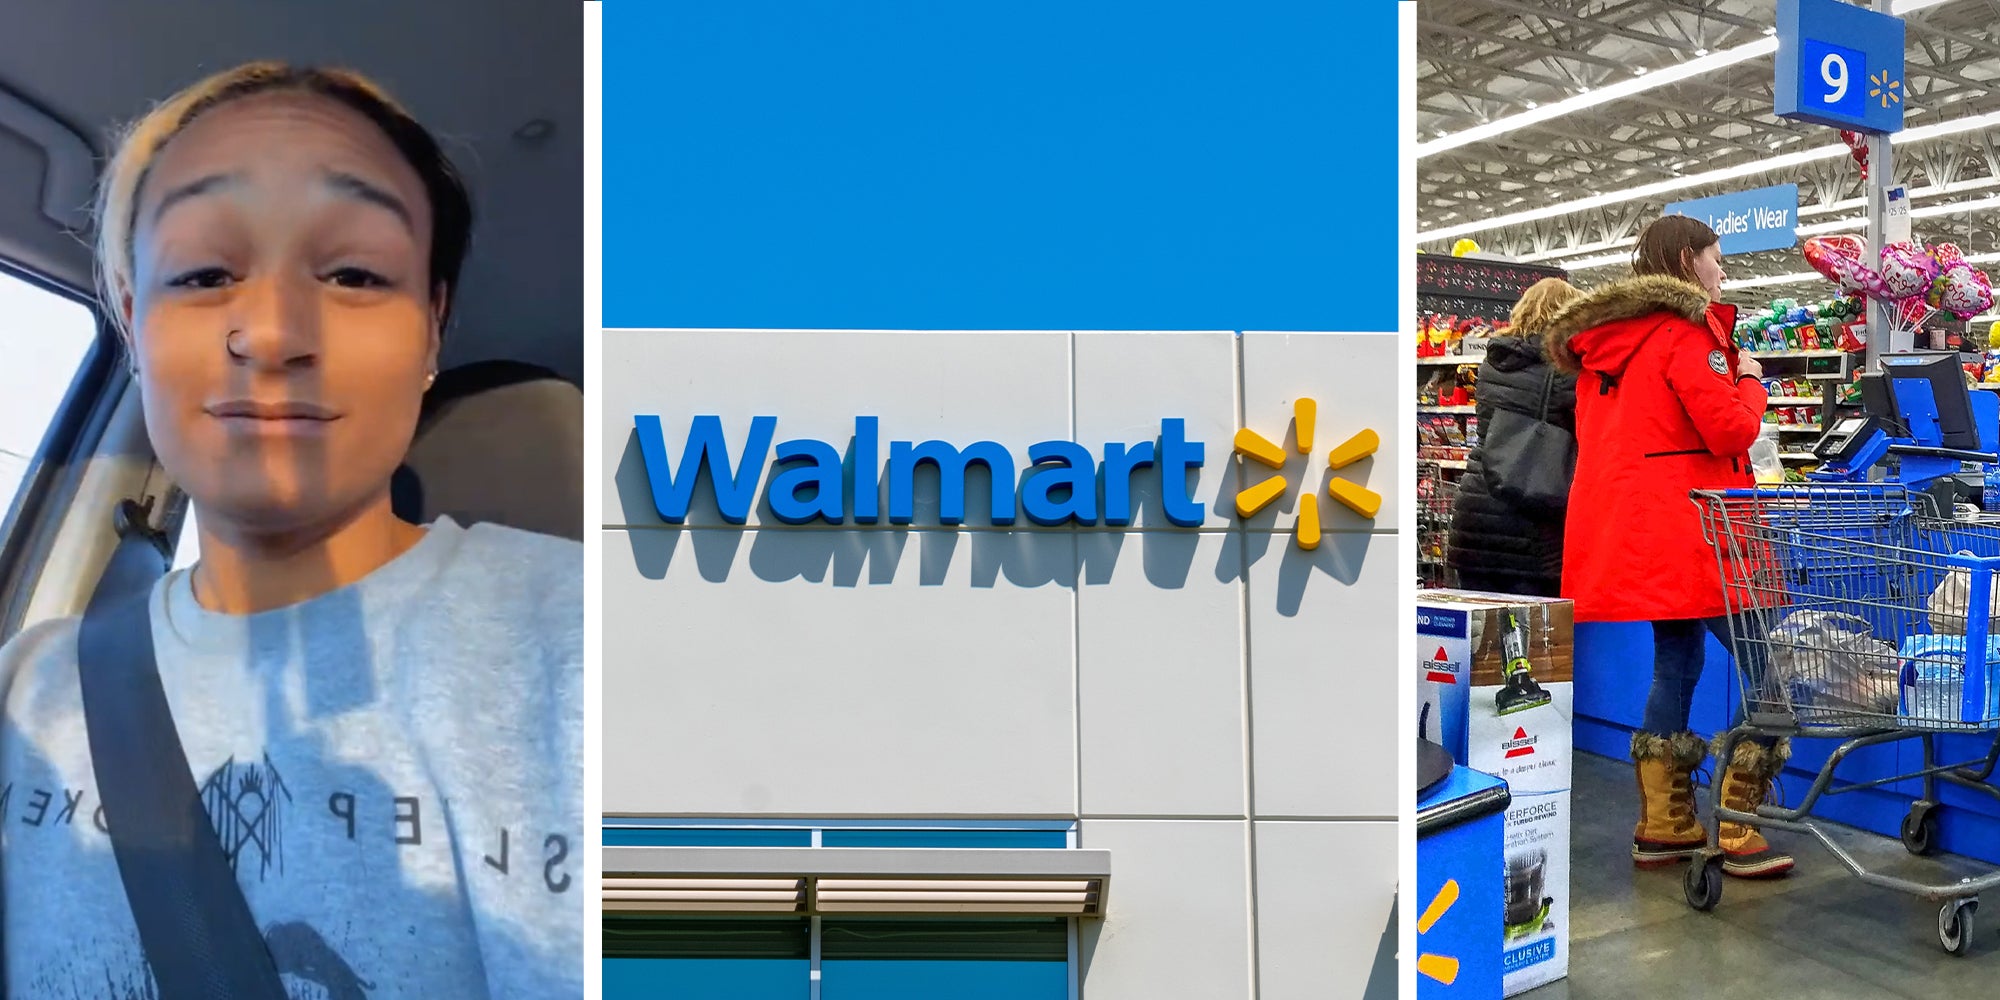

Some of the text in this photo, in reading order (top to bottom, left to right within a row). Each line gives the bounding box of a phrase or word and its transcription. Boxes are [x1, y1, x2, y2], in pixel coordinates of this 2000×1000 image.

[1821, 53, 1848, 103] 9
[1754, 206, 1788, 230] Wear
[634, 415, 1205, 526] Walmart
